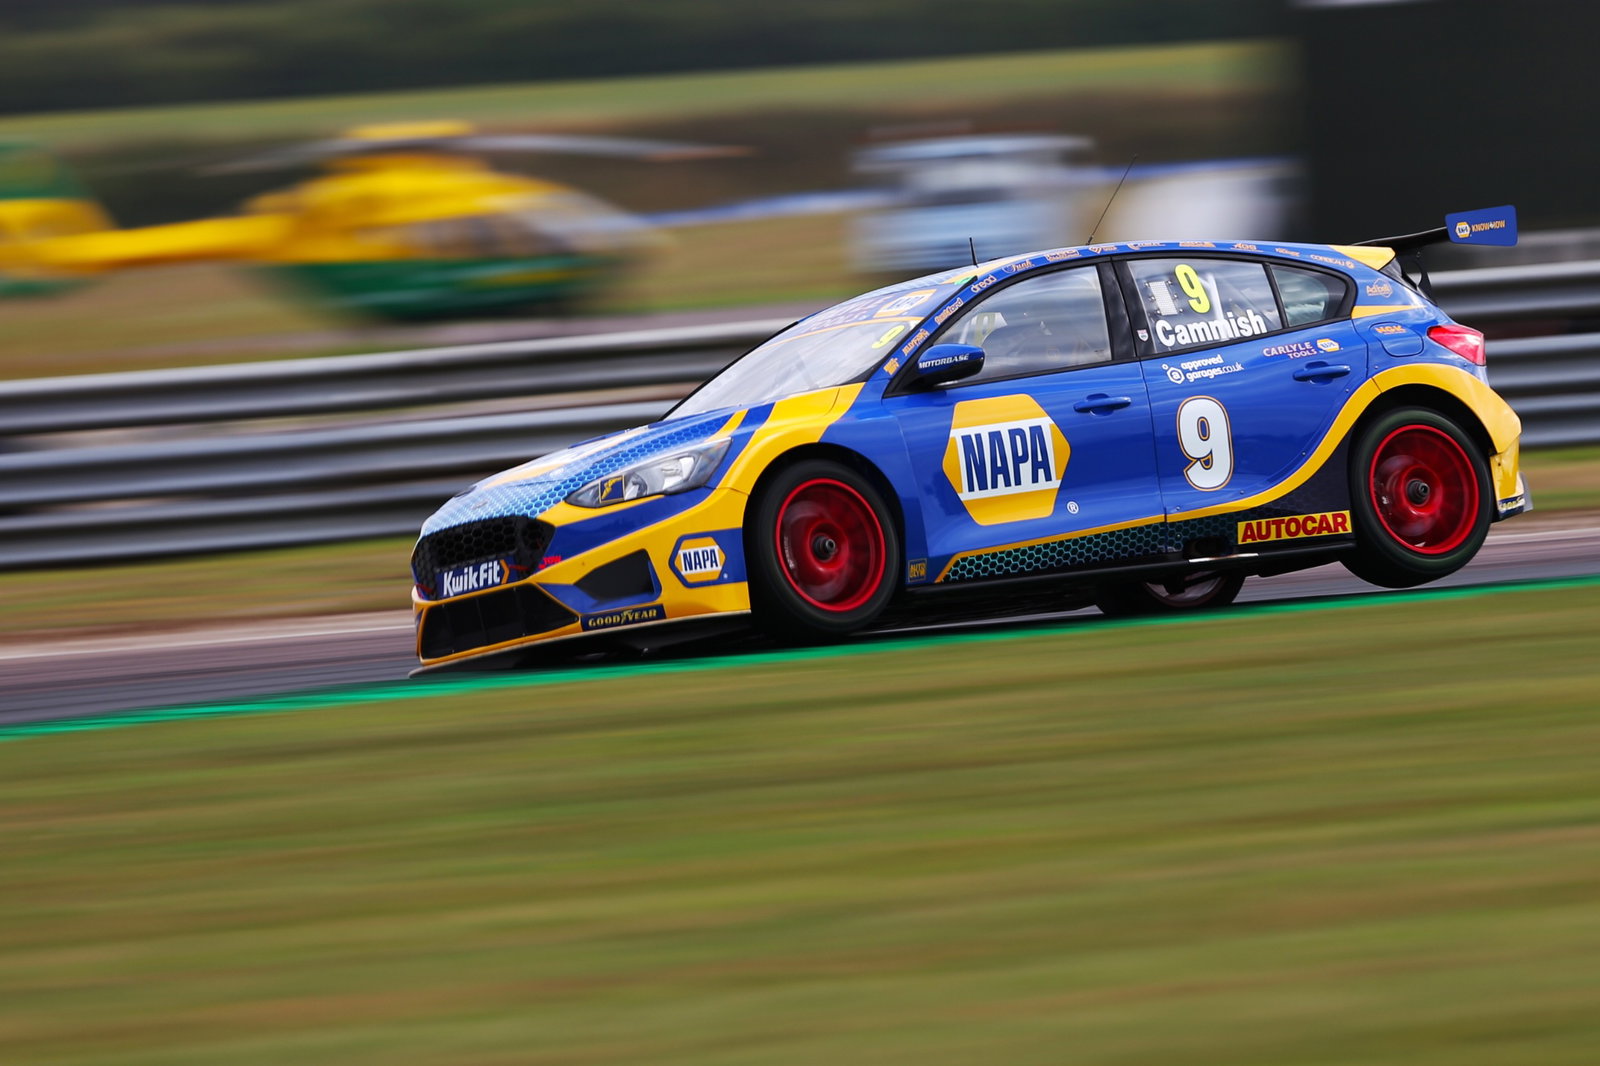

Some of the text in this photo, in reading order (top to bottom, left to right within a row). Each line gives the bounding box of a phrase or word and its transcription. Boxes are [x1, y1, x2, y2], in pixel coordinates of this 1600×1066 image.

[1174, 264, 1211, 313] 9
[1155, 309, 1268, 347] Cammish
[1263, 341, 1313, 357] CARLYLE
[1288, 348, 1318, 359] TOOLS
[918, 353, 970, 369] MOTORBASE
[1180, 354, 1224, 371] approved
[1186, 362, 1244, 382] garages.co.uk
[1176, 395, 1234, 492] 9
[961, 424, 1053, 493] NAPA
[1241, 512, 1349, 543] AUTOCAR
[682, 548, 719, 572] NAPA
[587, 608, 658, 628] GOODYEAR
